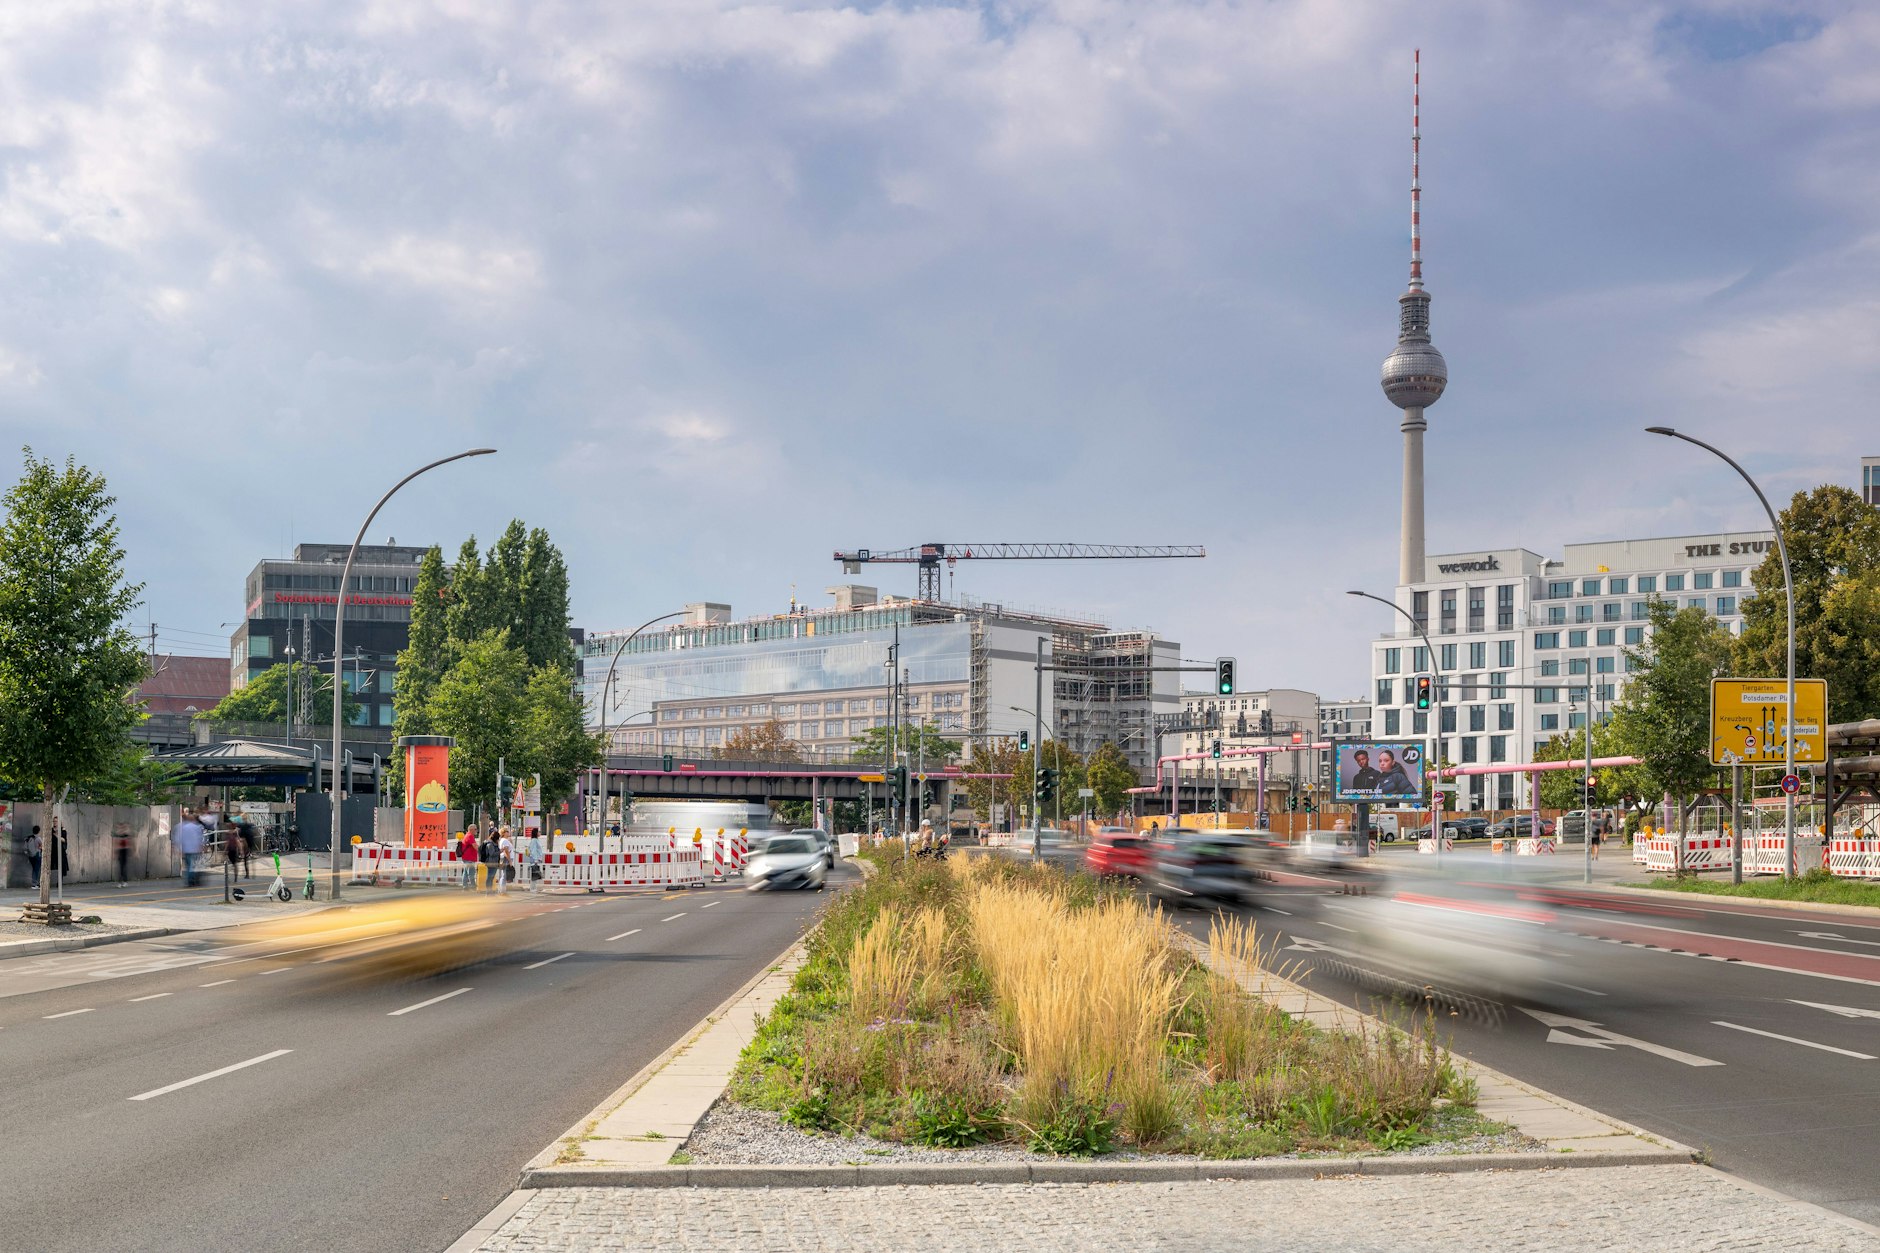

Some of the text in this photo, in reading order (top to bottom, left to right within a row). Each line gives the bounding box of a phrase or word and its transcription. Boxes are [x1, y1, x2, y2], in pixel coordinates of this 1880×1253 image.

[1685, 543, 1721, 558] THE
[1437, 554, 1500, 574] wework
[275, 591, 413, 606] Sozialverbad Deutschlan
[1742, 684, 1774, 692] Tiergarten
[1743, 694, 1777, 702] Potsdamer
[1719, 715, 1753, 723] Kreuzberg
[1404, 749, 1419, 760] JD
